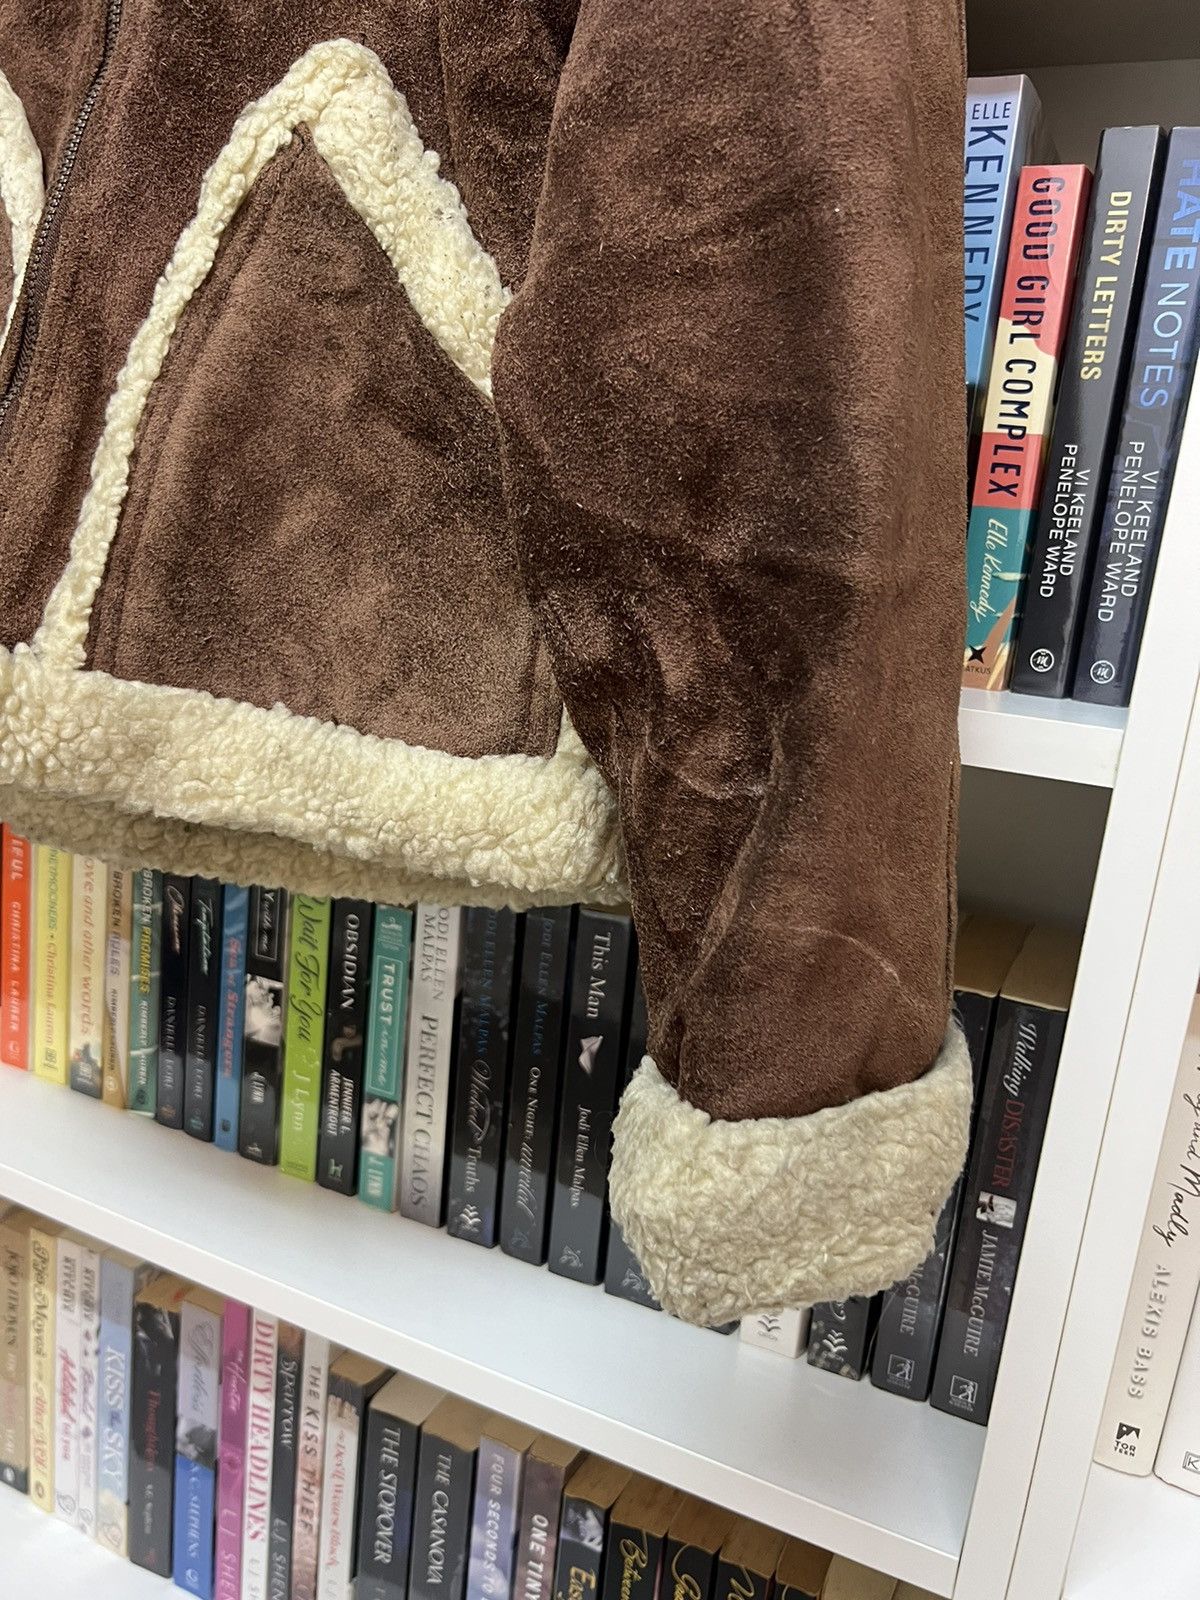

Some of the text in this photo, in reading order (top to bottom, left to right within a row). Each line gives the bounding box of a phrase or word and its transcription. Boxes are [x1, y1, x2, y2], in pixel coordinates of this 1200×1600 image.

[972, 101, 1012, 120] ELLE
[964, 126, 1006, 322] KENNEDY
[1080, 190, 1132, 381] DIRTY LETTERS
[1139, 159, 1200, 408] HATE NOTES
[988, 177, 1065, 497] GOOD GIRL COMPLEX
[1039, 443, 1078, 598] PENELOPE WARD
[1060, 469, 1091, 577] VI KEELAND
[1097, 441, 1145, 623] PENELOPE WARD
[1121, 470, 1159, 598] VI KEELAND
[970, 517, 1008, 624] Elle Kennedy
[110, 870, 123, 927] BROKEN
[141, 868, 154, 924] BROKEN
[293, 953, 321, 998] For
[340, 912, 361, 1010] OBSIDIAN
[421, 913, 438, 983] MALPAS
[431, 907, 451, 1001] ODI ELLEN
[586, 931, 613, 1020] This Man
[288, 996, 323, 1043] You
[377, 963, 396, 1026] TRUST
[531, 999, 549, 1056] MALPAS
[291, 1089, 309, 1132] Lynn
[326, 1069, 341, 1137] ARMENTROUT
[411, 1014, 440, 1209] PERFECT CHAOS
[992, 1022, 1038, 1188] Walking DISASTER
[464, 1145, 482, 1193] Truths
[570, 1104, 592, 1209] Jodi Ellen Malpas
[1152, 1163, 1200, 1248] Madly
[963, 1229, 999, 1357] JAMIE McGUIRE
[1127, 1263, 1171, 1400] ALEXIS BASS
[104, 1346, 126, 1411] KISS
[254, 1319, 275, 1397] DIRTY
[307, 1364, 322, 1397] THE
[280, 1358, 298, 1452] Sparrow
[304, 1406, 321, 1457] KISS
[381, 1427, 401, 1468] THE
[102, 1427, 124, 1486] SKY
[248, 1403, 273, 1543] HEADLINES
[488, 1452, 505, 1495] FOUR
[298, 1468, 318, 1536] THIEF
[373, 1470, 398, 1565] STOPOVER
[426, 1453, 452, 1585] THE CASANOVA
[481, 1497, 503, 1576] SECONDS
[525, 1513, 549, 1600] ONE TINY
